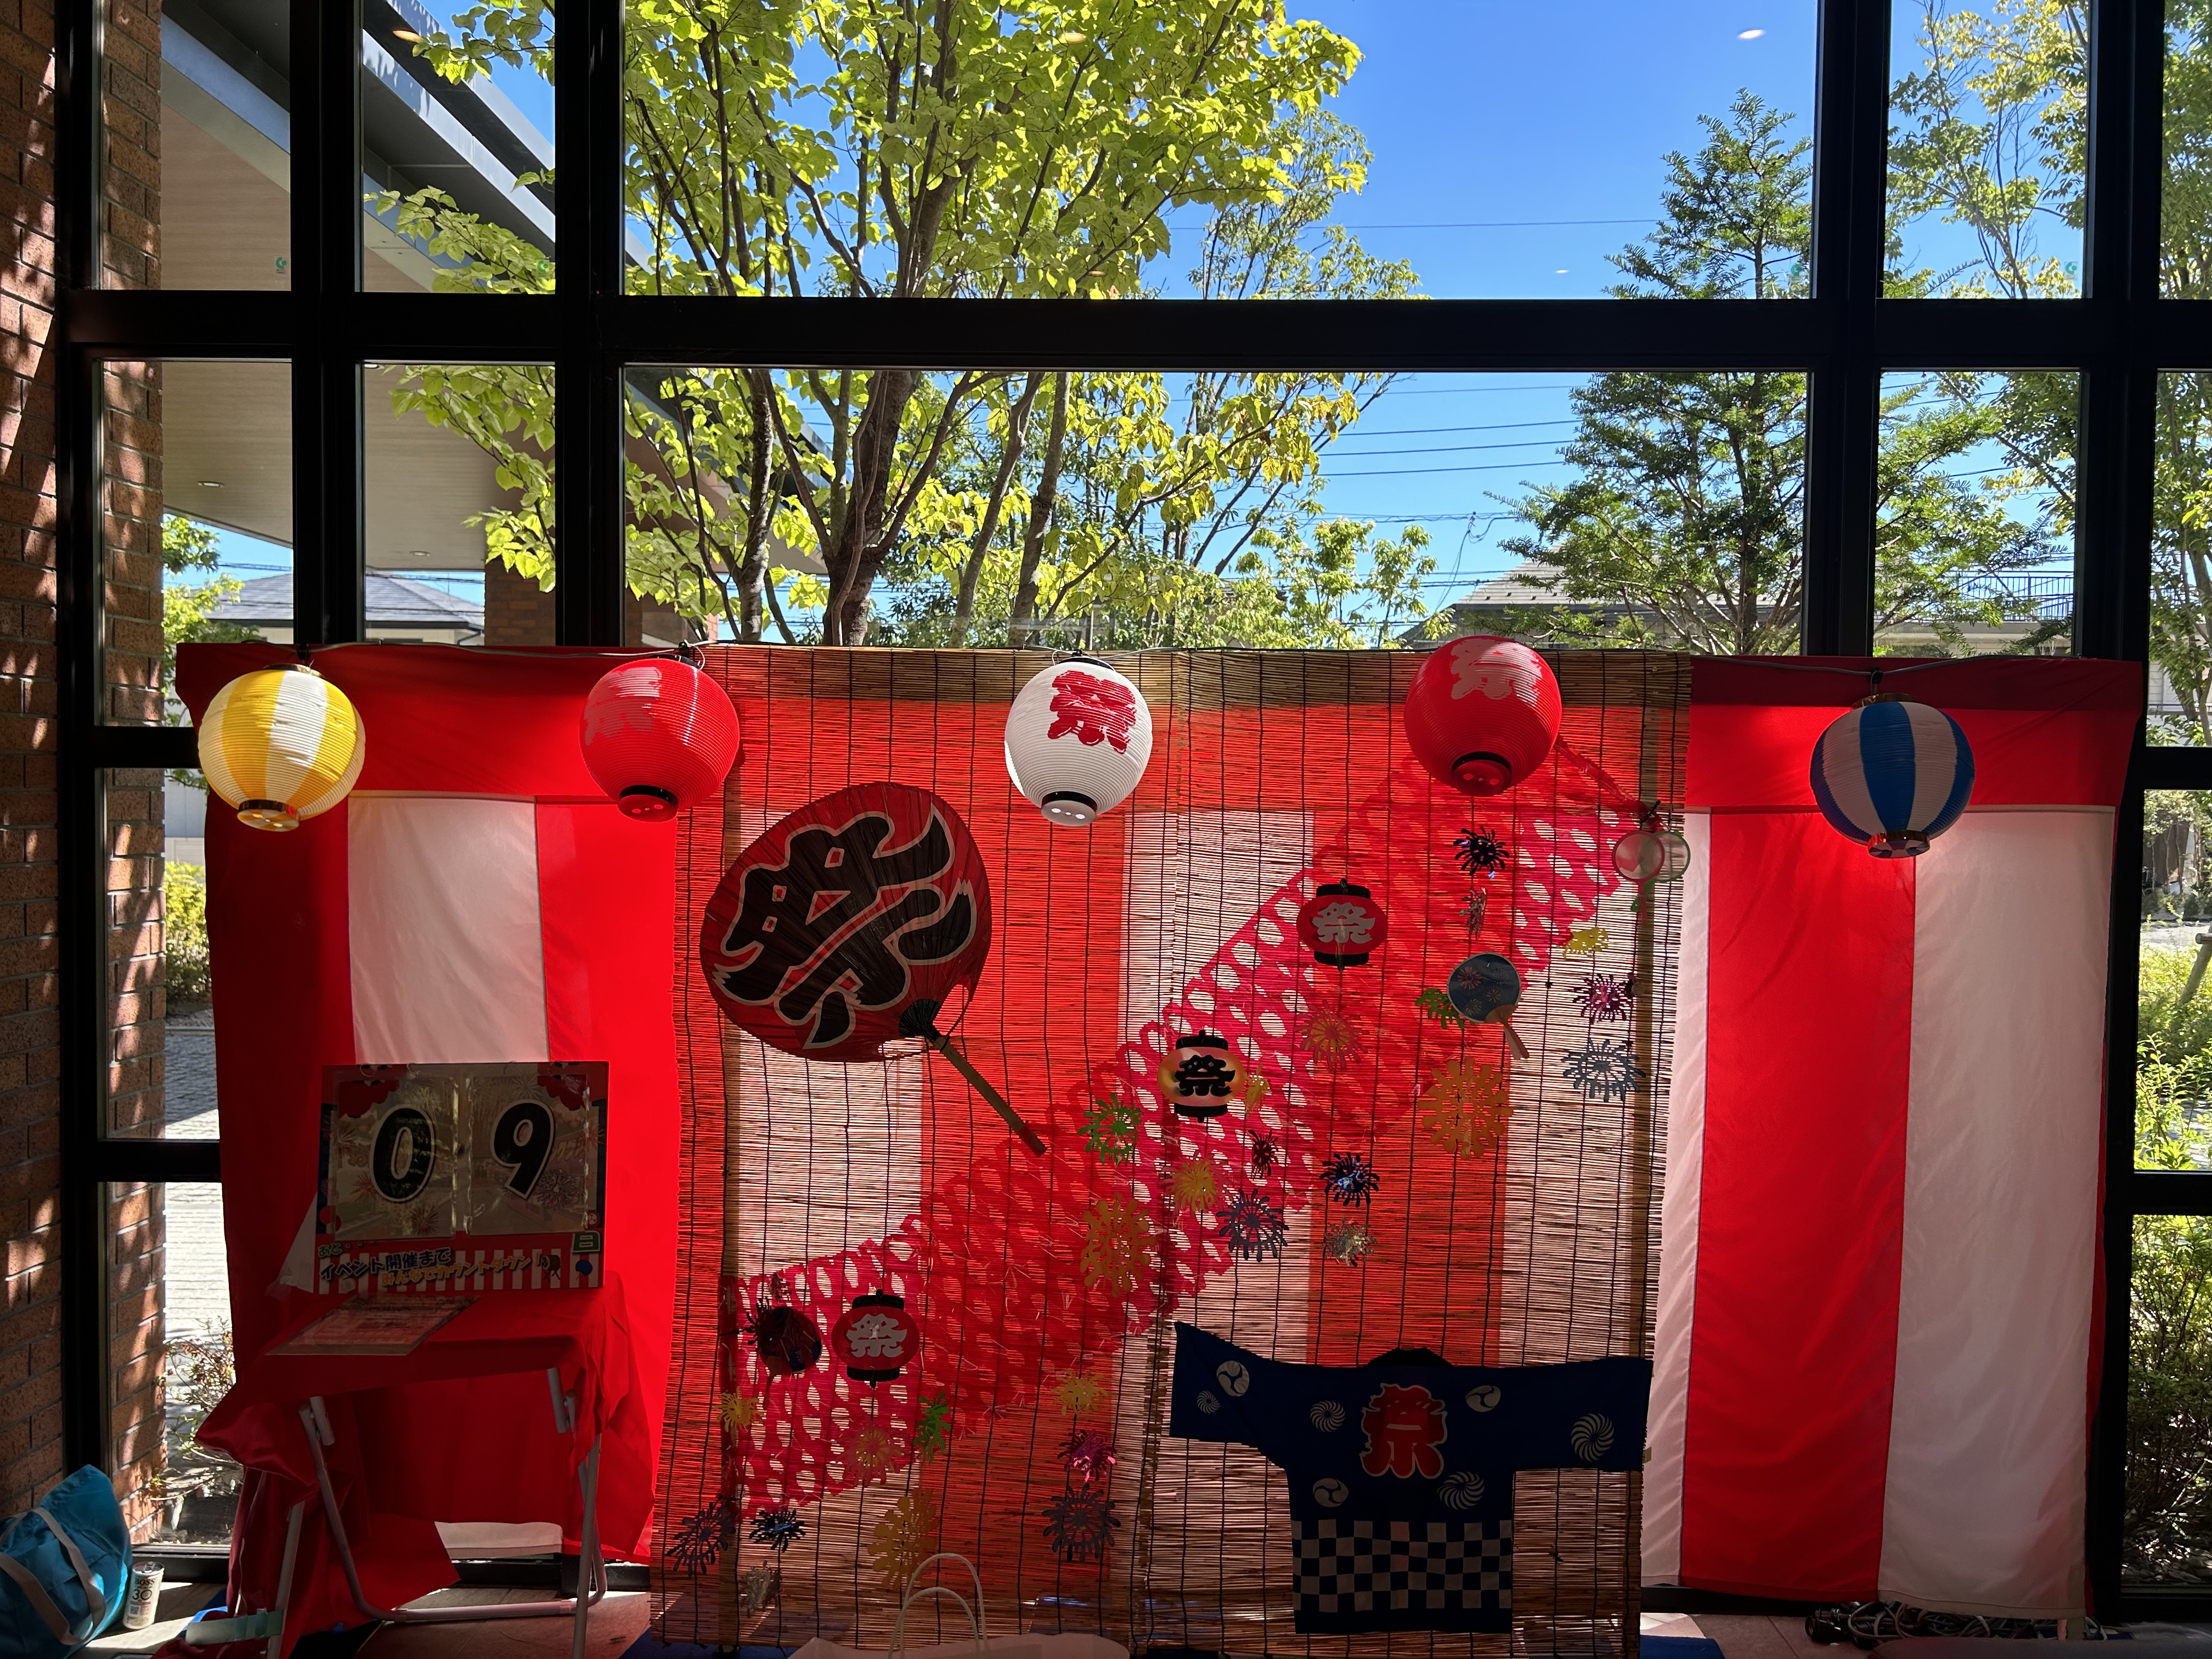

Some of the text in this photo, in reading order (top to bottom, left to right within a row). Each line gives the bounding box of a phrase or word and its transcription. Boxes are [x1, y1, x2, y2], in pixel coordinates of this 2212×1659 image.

[1047, 670, 1137, 755] 祭
[712, 800, 978, 1050] 祭
[1312, 901, 1376, 944] 祭
[1174, 1054, 1236, 1097] 祭
[370, 1098, 555, 1203] 0 9
[320, 1246, 452, 1281] イベント開催まで
[847, 1313, 907, 1357] 祭
[1359, 1383, 1448, 1480] 祭
